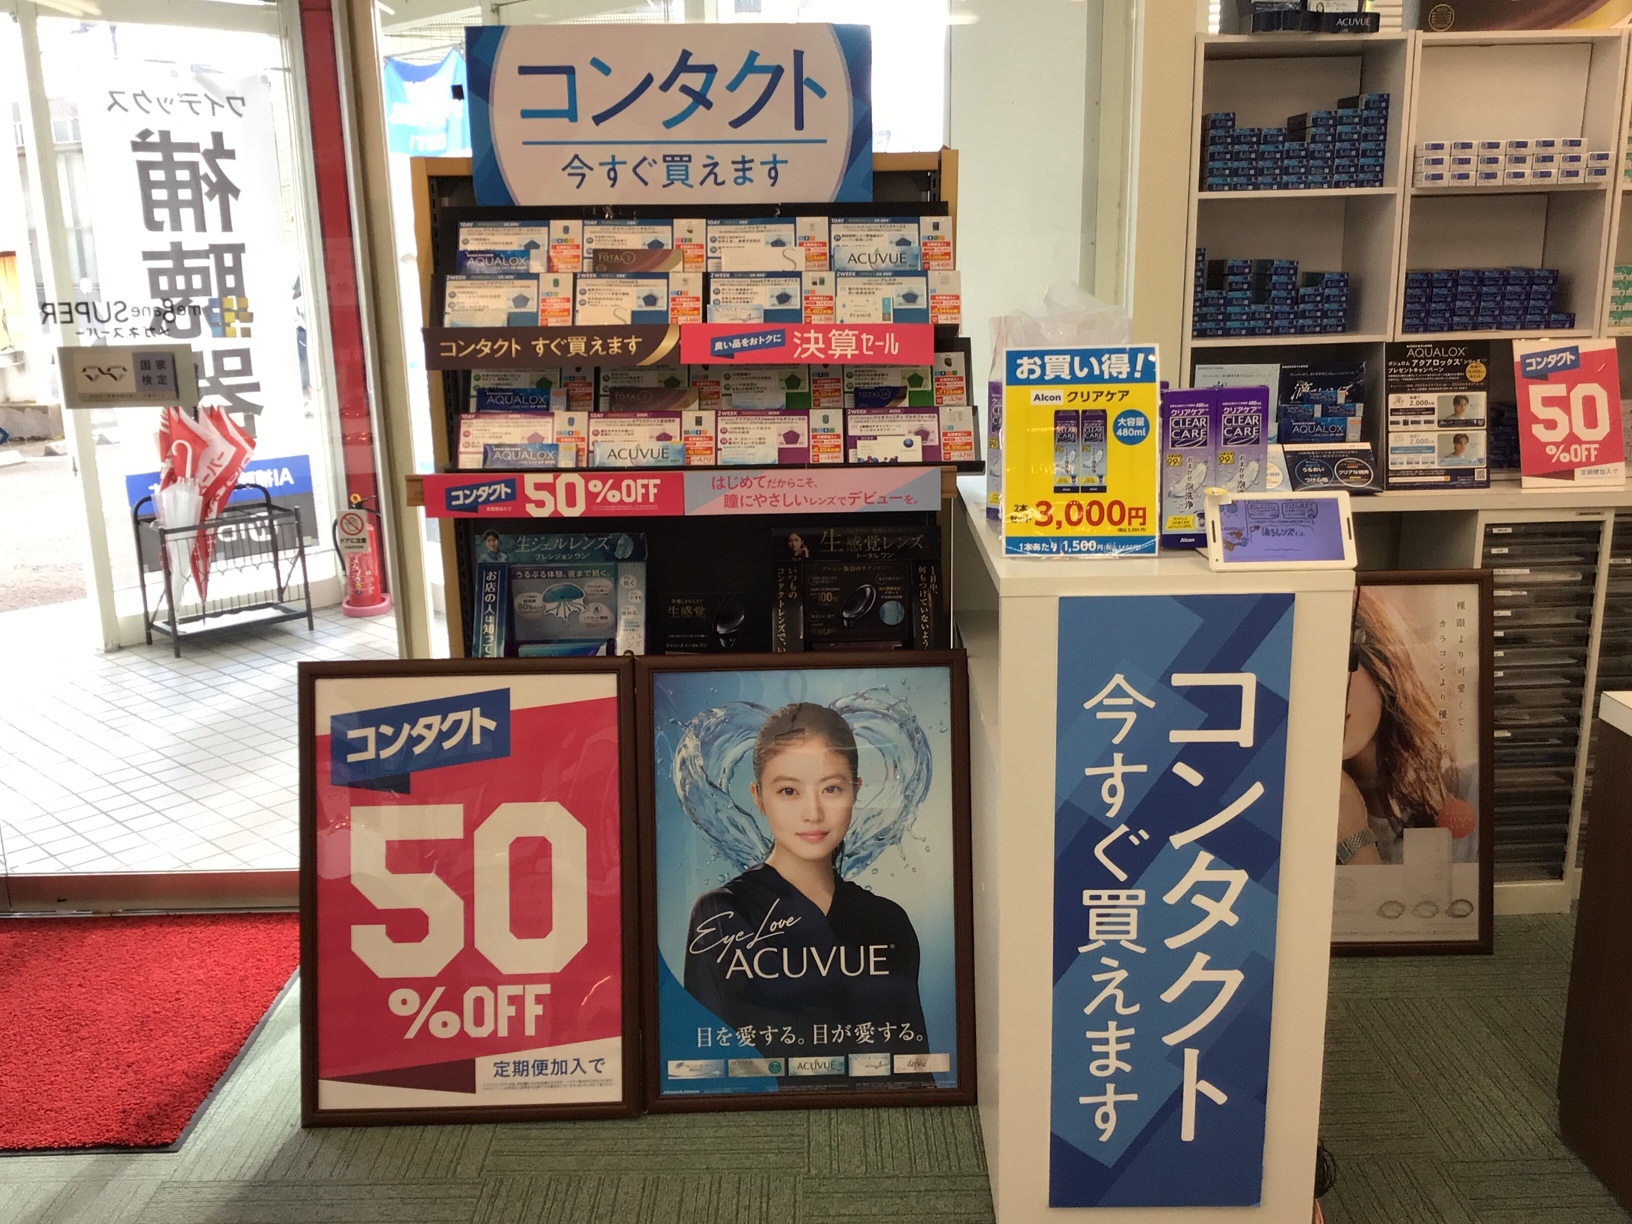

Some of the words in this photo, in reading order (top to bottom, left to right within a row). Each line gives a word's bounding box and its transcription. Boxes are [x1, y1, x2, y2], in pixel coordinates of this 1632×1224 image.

[1336, 18, 1371, 27] ACUVUE
[518, 48, 827, 131] コンタクト
[561, 153, 788, 189] 今すぐ買えます
[467, 256, 526, 266] AQUALOX
[847, 252, 907, 264] ACUVUE
[440, 338, 521, 358] コンタクト
[531, 335, 643, 357] すぐ買えます
[714, 333, 782, 351] 良い品をおトクに
[793, 329, 899, 359] 決算セール
[1407, 347, 1466, 358] AQUALOX
[1016, 353, 1145, 380] お買い得!
[1412, 359, 1460, 367] アクアロックス
[1525, 353, 1575, 371] コンタクト
[486, 395, 547, 405] AQUALOX
[1033, 393, 1062, 402] Alcon
[1067, 390, 1130, 403] クリアケア
[1171, 408, 1205, 416] クリアケア
[1223, 406, 1257, 414] クリアケア
[1529, 383, 1610, 443] 50
[1117, 416, 1145, 426] 大容量
[1171, 417, 1207, 428] CLEAR
[1224, 415, 1259, 426] CLEAR
[1292, 425, 1344, 434] AQUALOX
[1116, 428, 1146, 437] 480ml
[1171, 428, 1207, 439] CARE
[1224, 426, 1259, 436] CARE
[493, 451, 555, 460] AQUALOX
[607, 448, 670, 460] ACUVUE
[1545, 443, 1600, 463] %OFF
[711, 475, 818, 490] はじめてだからこそ、
[1236, 454, 1246, 493] おまかせ泡
[1184, 456, 1195, 510] おまかせ泡洗浄
[451, 482, 511, 506] コンタクト
[724, 491, 919, 509] 瞳にやさしいレンズでデビューを。
[1013, 504, 1028, 512] 2本
[1034, 500, 1147, 530] 3,000円
[515, 534, 613, 553] 生ジェルレンズ
[819, 528, 925, 553] 生感覚レンズ
[668, 605, 706, 618] 生感覚
[1456, 600, 1466, 733] 裸眼より可愛くて、
[1438, 619, 1448, 751] カラコンより優しい
[346, 706, 497, 763] コンタクト
[350, 801, 588, 979] 50
[1077, 673, 1156, 1143] 今すぐ買えます
[1160, 672, 1265, 1142] コンタクト
[689, 911, 754, 963] Eye
[746, 897, 802, 949] Love
[725, 944, 890, 979] ACUVUE
[388, 983, 551, 1039] %OFF
[697, 1022, 924, 1048] 目を愛する。目が愛する。
[493, 1058, 606, 1078] 定期便加入で
[797, 1061, 836, 1071] ACUVUE
[906, 1059, 928, 1069] define
